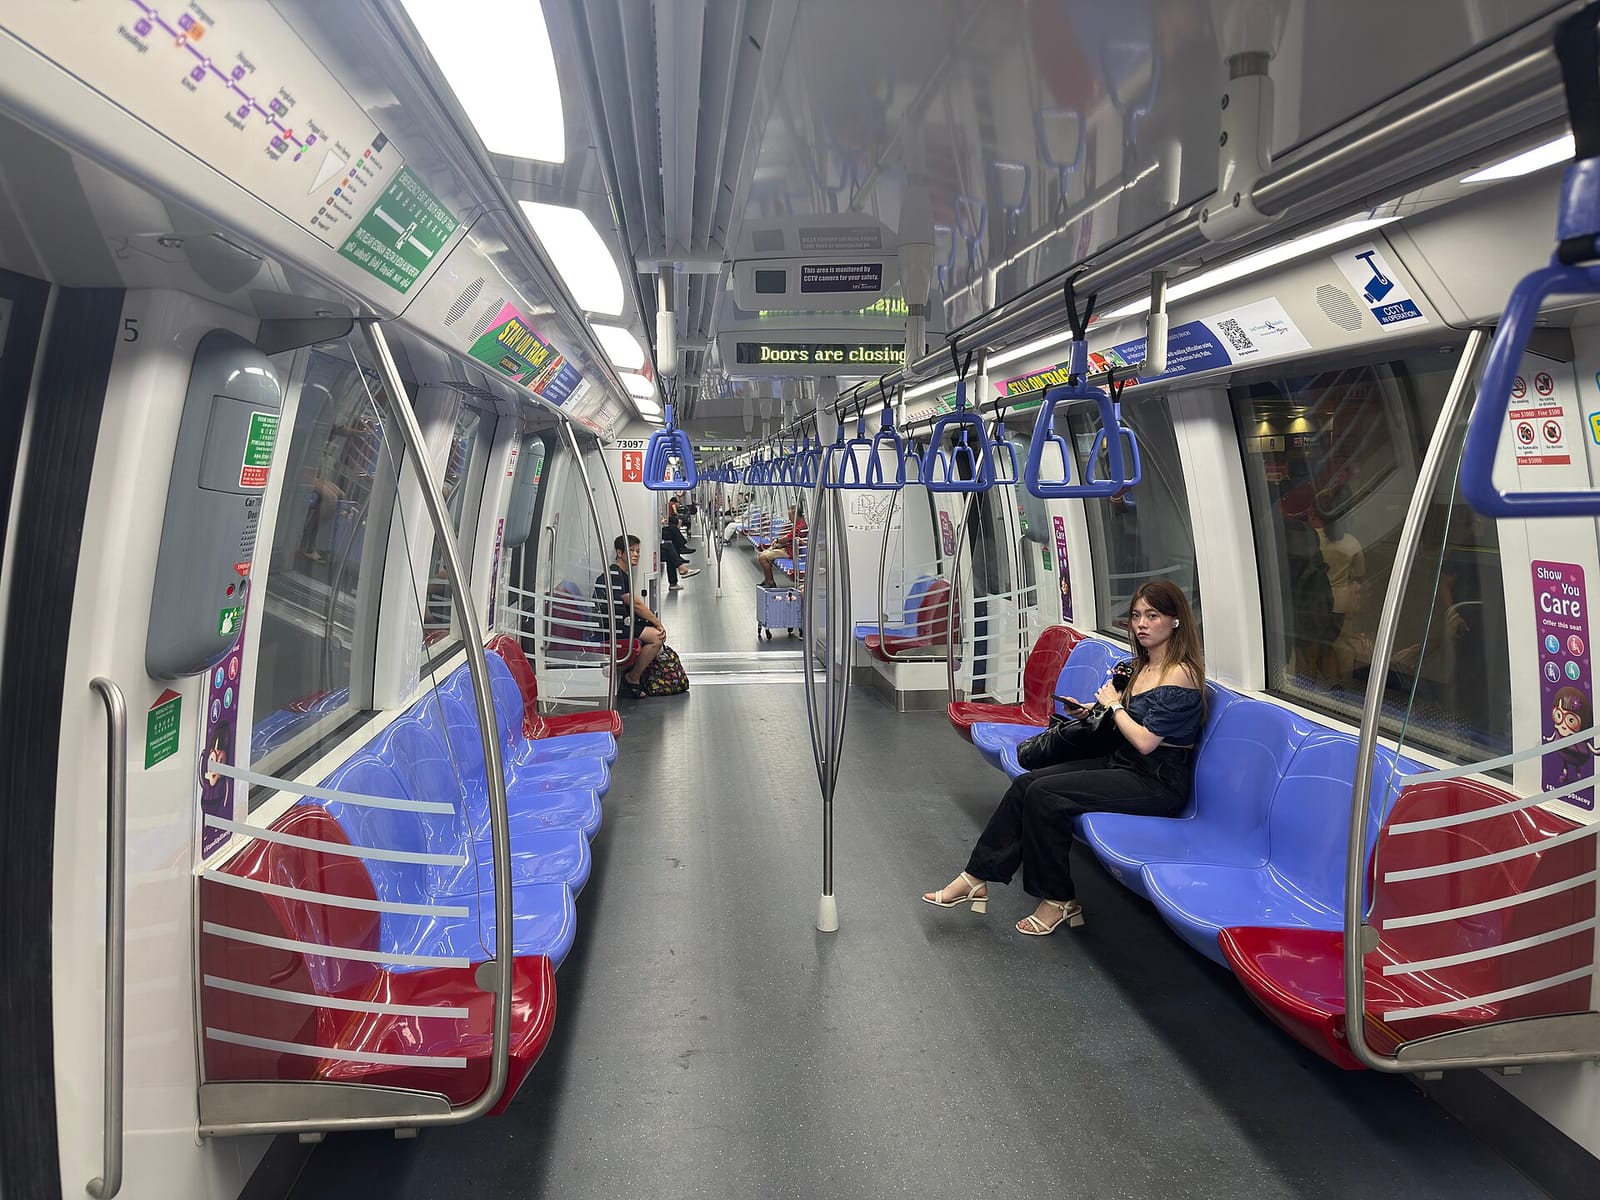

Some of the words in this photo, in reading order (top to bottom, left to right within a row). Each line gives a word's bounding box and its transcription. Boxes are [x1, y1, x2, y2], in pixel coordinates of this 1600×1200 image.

[1383, 303, 1404, 316] CCTV
[1387, 311, 1418, 321] OPERATION
[124, 319, 139, 342] 5
[498, 319, 527, 349] STAY
[760, 346, 809, 361] Doors
[814, 350, 844, 361] are
[848, 346, 906, 364] closing
[1008, 380, 1031, 395] STAY
[1027, 375, 1046, 390] ON
[617, 440, 643, 448] 73097
[1537, 567, 1562, 581] Show
[1561, 583, 1580, 596] You
[1540, 592, 1581, 618] Care
[1557, 621, 1569, 630] this
[1569, 623, 1582, 632] seat
